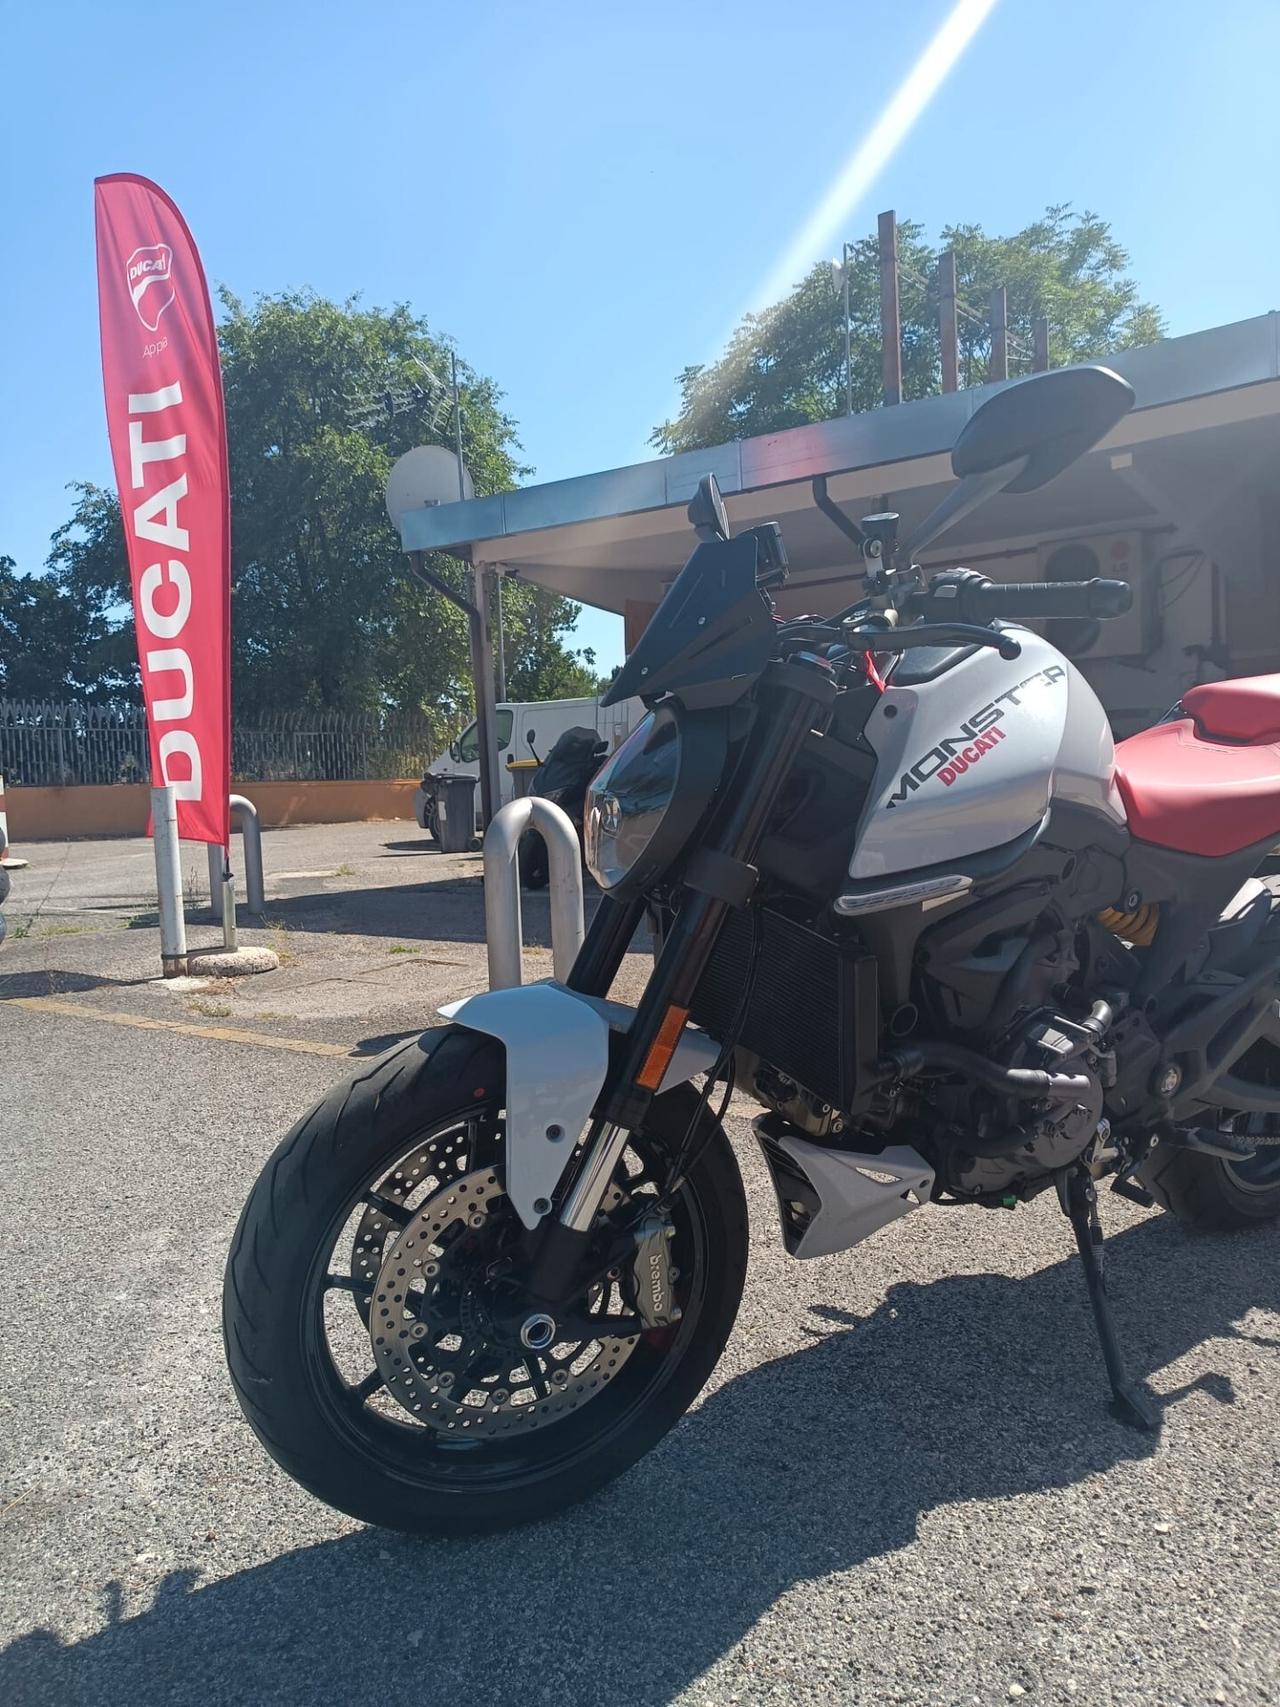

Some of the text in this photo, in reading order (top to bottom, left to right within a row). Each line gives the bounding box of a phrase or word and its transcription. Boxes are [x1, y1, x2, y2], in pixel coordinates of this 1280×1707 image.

[130, 253, 166, 280] DUCAI
[128, 380, 202, 801] DUCATI
[936, 726, 1006, 786] DUCATI
